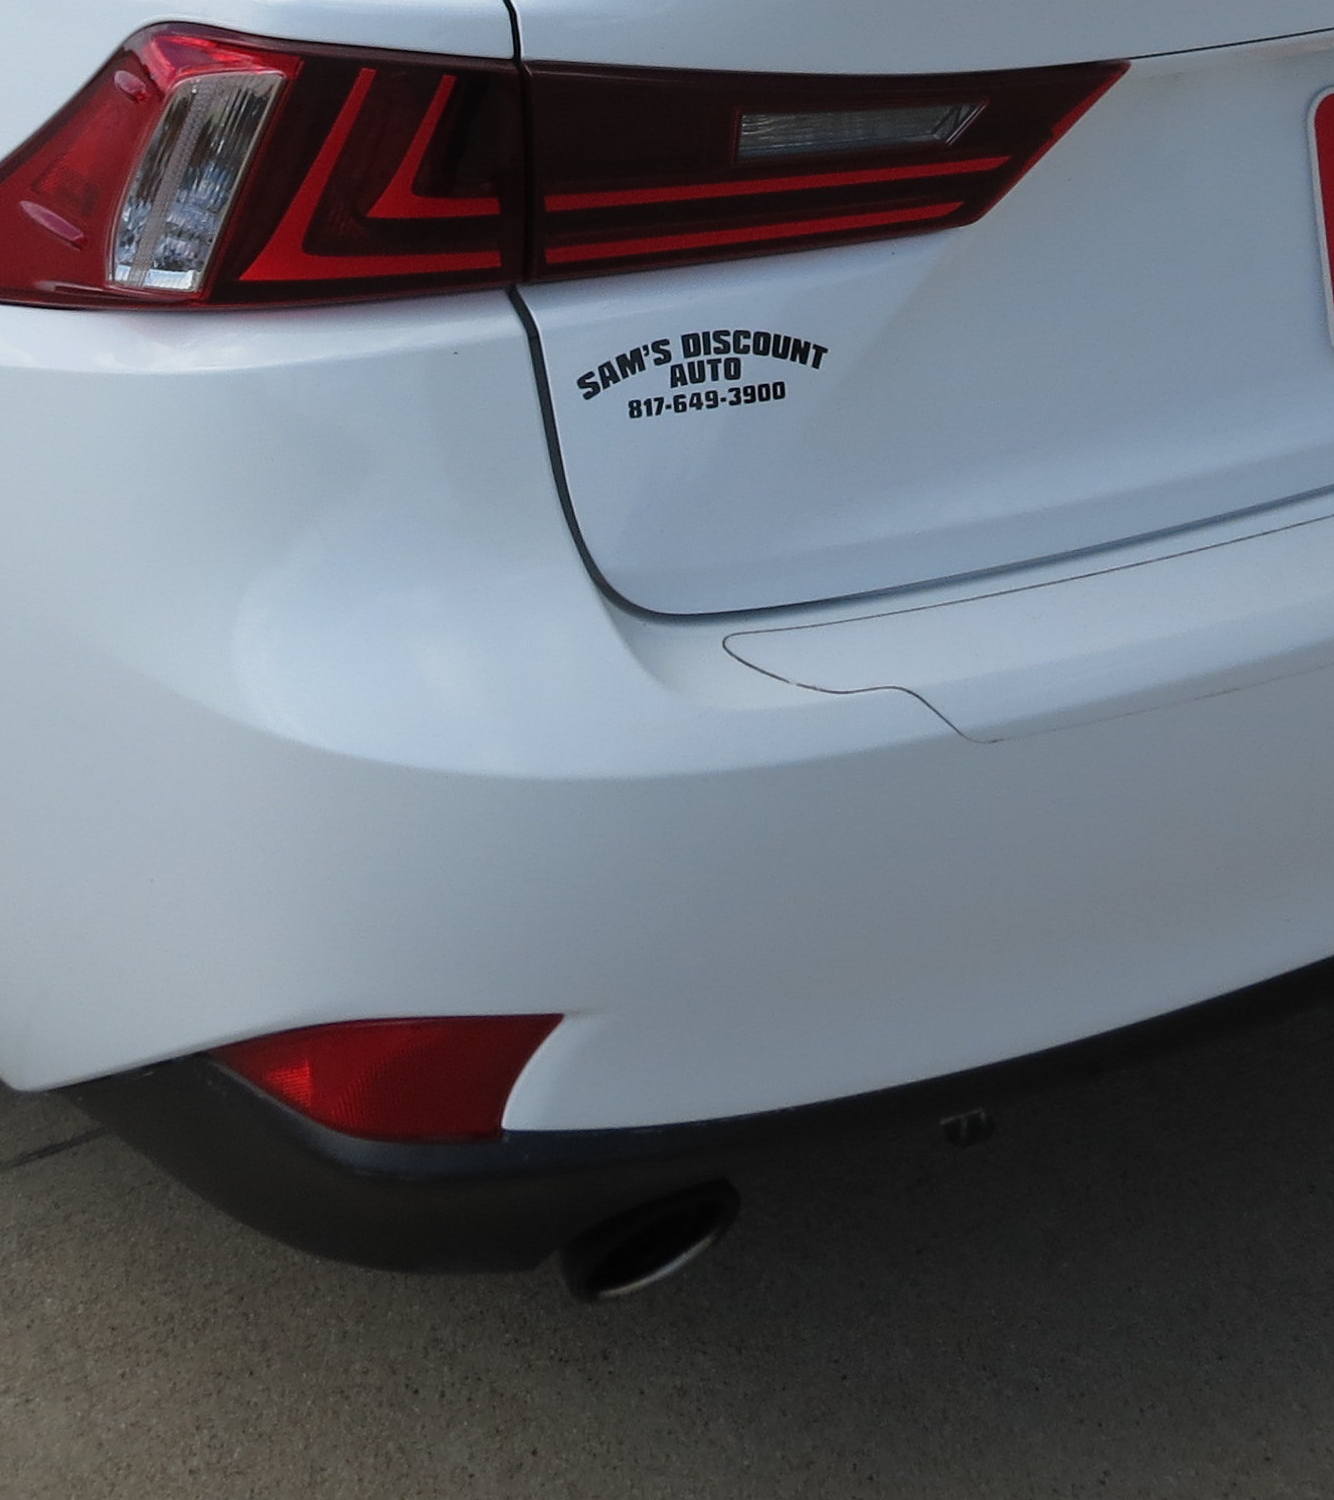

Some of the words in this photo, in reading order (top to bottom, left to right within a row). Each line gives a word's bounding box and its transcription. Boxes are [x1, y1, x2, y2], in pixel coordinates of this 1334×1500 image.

[576, 338, 672, 401] SAM'S
[681, 329, 829, 370] DISCOUNT
[670, 357, 742, 389] AUTO
[628, 381, 786, 419] 817-649-3900
